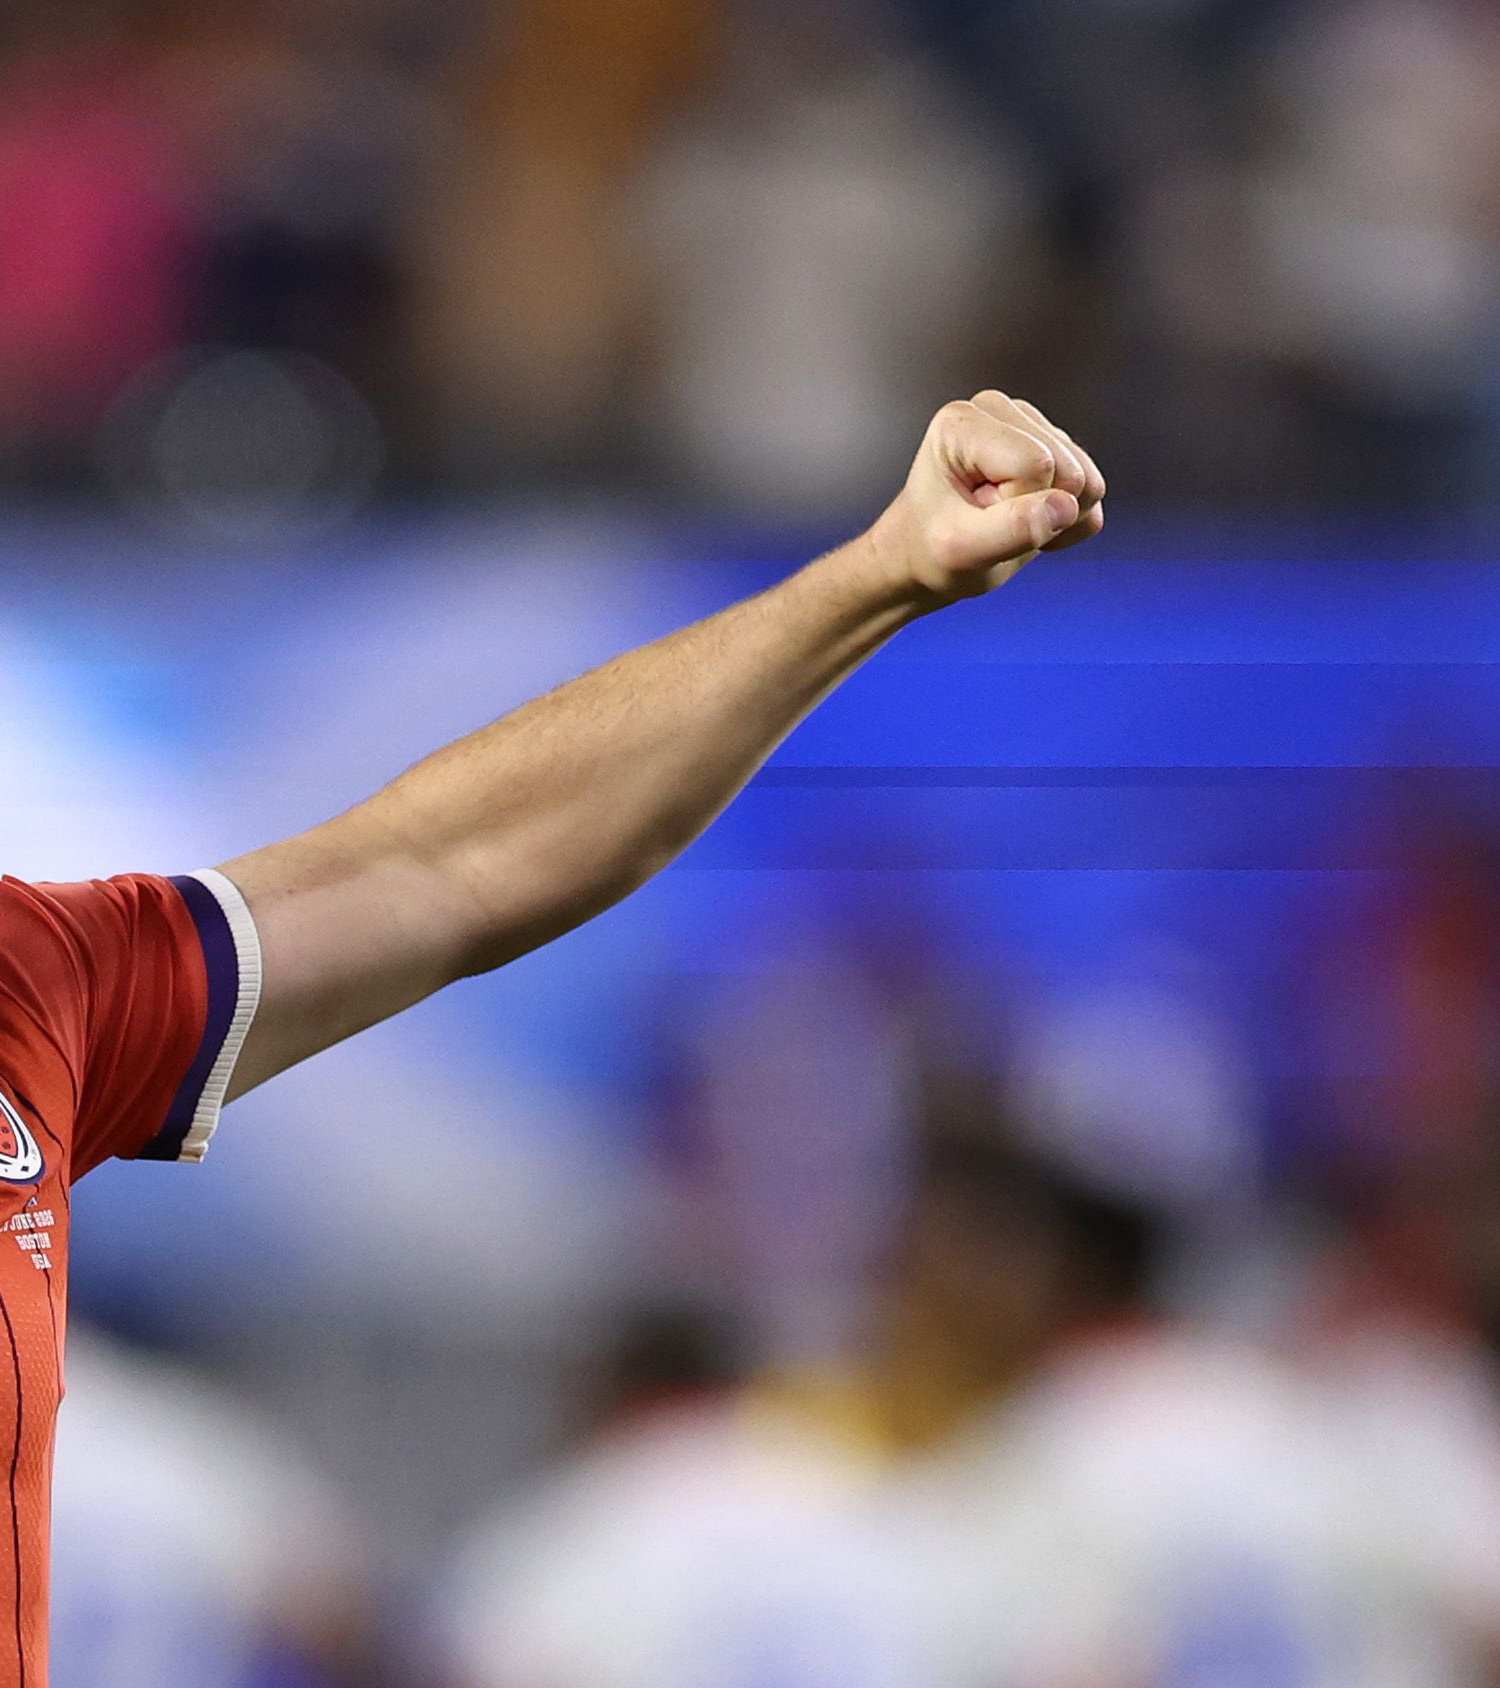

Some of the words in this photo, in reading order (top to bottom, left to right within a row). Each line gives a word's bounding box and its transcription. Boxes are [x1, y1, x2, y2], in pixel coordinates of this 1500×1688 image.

[9, 1213, 36, 1231] JUNE
[14, 1232, 52, 1250] BOSTON
[30, 1253, 52, 1270] USA
